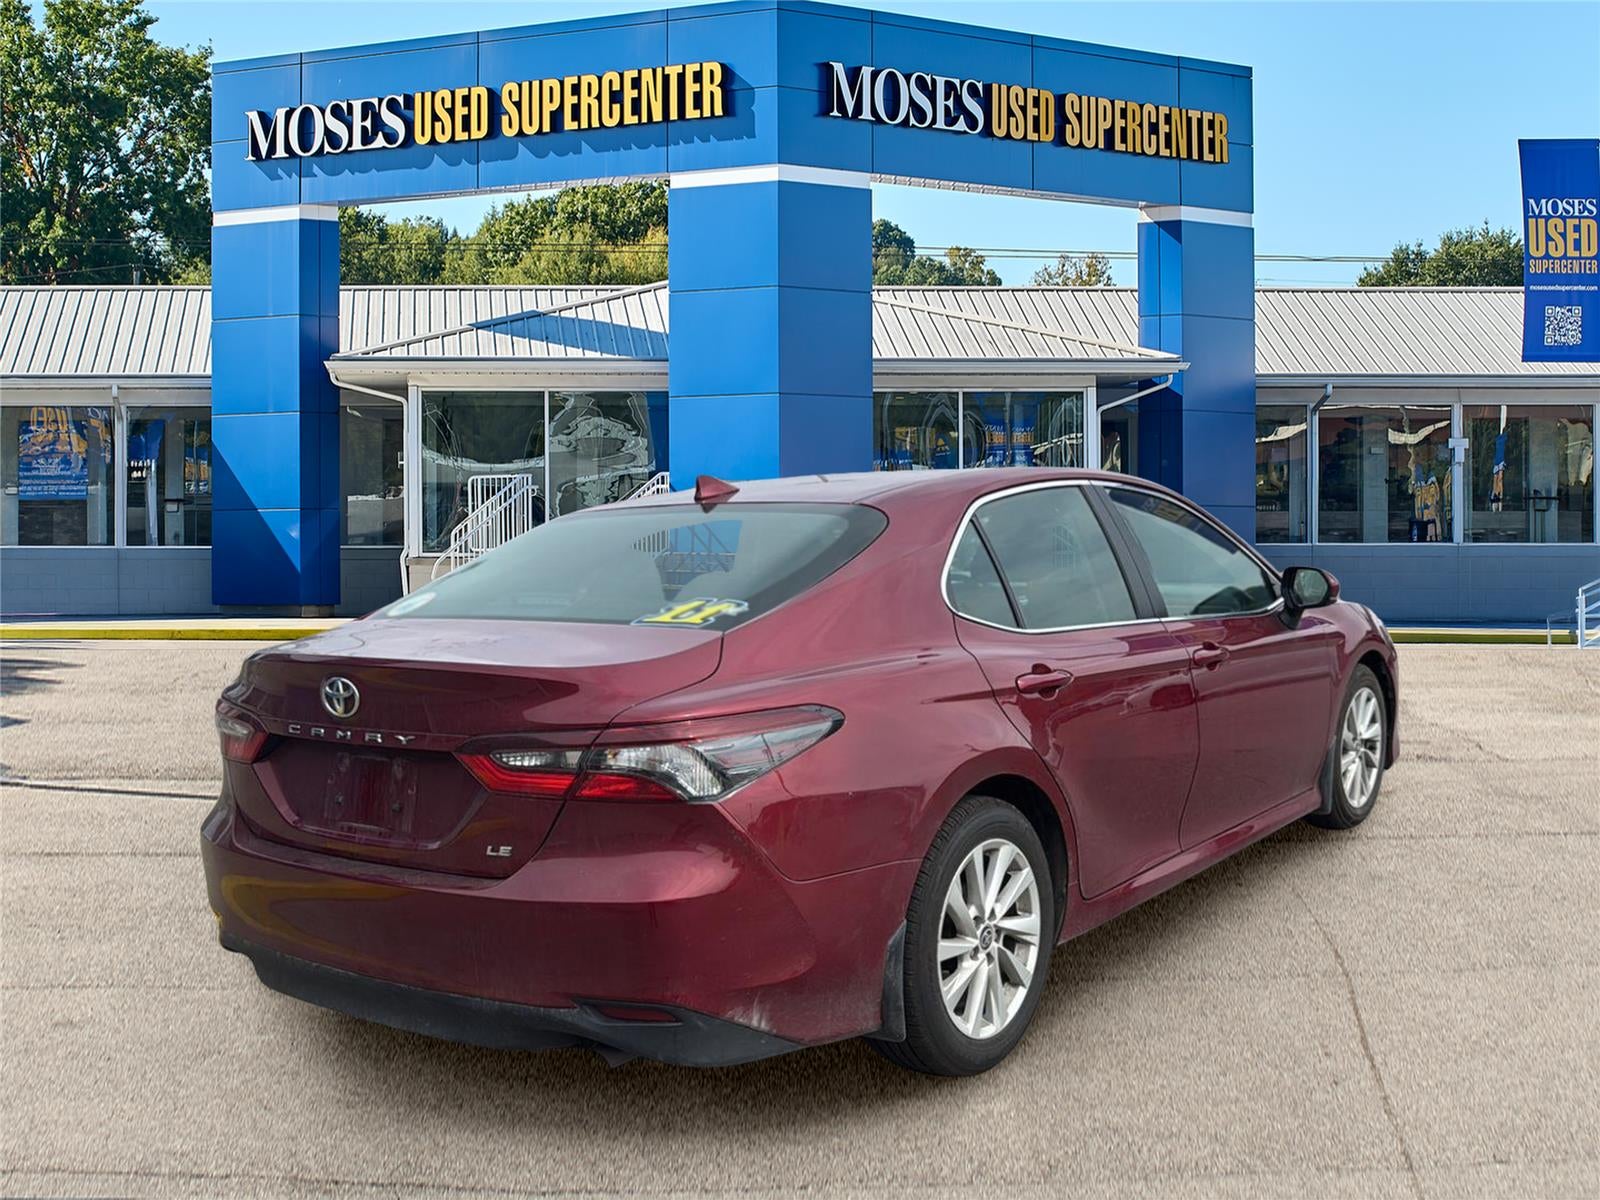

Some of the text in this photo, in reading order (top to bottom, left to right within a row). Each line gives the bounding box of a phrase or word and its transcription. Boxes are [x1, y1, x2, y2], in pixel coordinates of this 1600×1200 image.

[244, 61, 724, 161] MOSES USED SUPERCENTER
[828, 61, 1229, 164] MOSES USED SUPERCENTER
[1527, 198, 1597, 217] MOSES
[1528, 217, 1598, 258] USED
[1529, 259, 1598, 275] SUPERCENTER
[288, 724, 416, 745] CAMRY
[486, 845, 513, 857] LE
